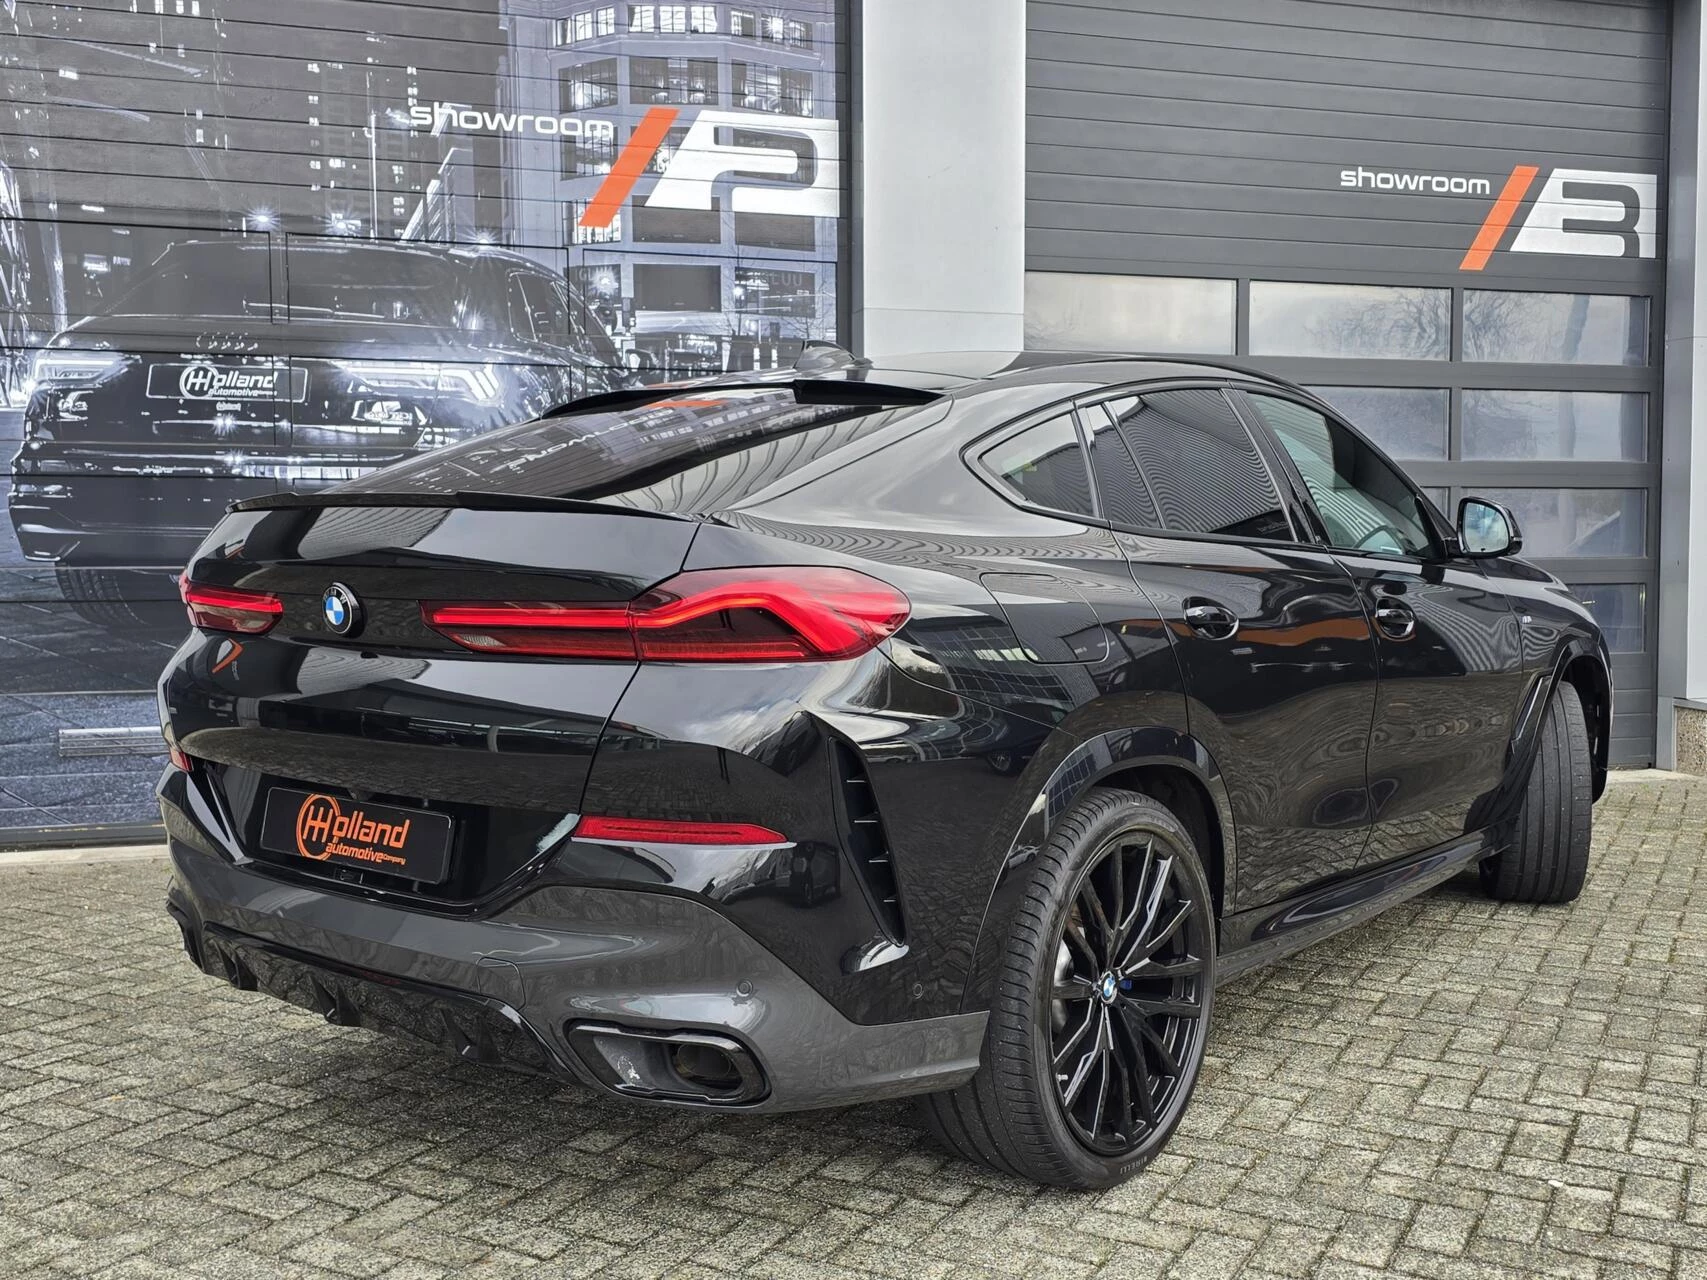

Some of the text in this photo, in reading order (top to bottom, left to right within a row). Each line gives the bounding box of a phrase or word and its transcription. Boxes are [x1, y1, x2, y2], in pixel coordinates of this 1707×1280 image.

[410, 102, 614, 138] showroom
[1340, 166, 1491, 195] showroom
[302, 804, 411, 849] Holland
[325, 841, 384, 863] automotive
